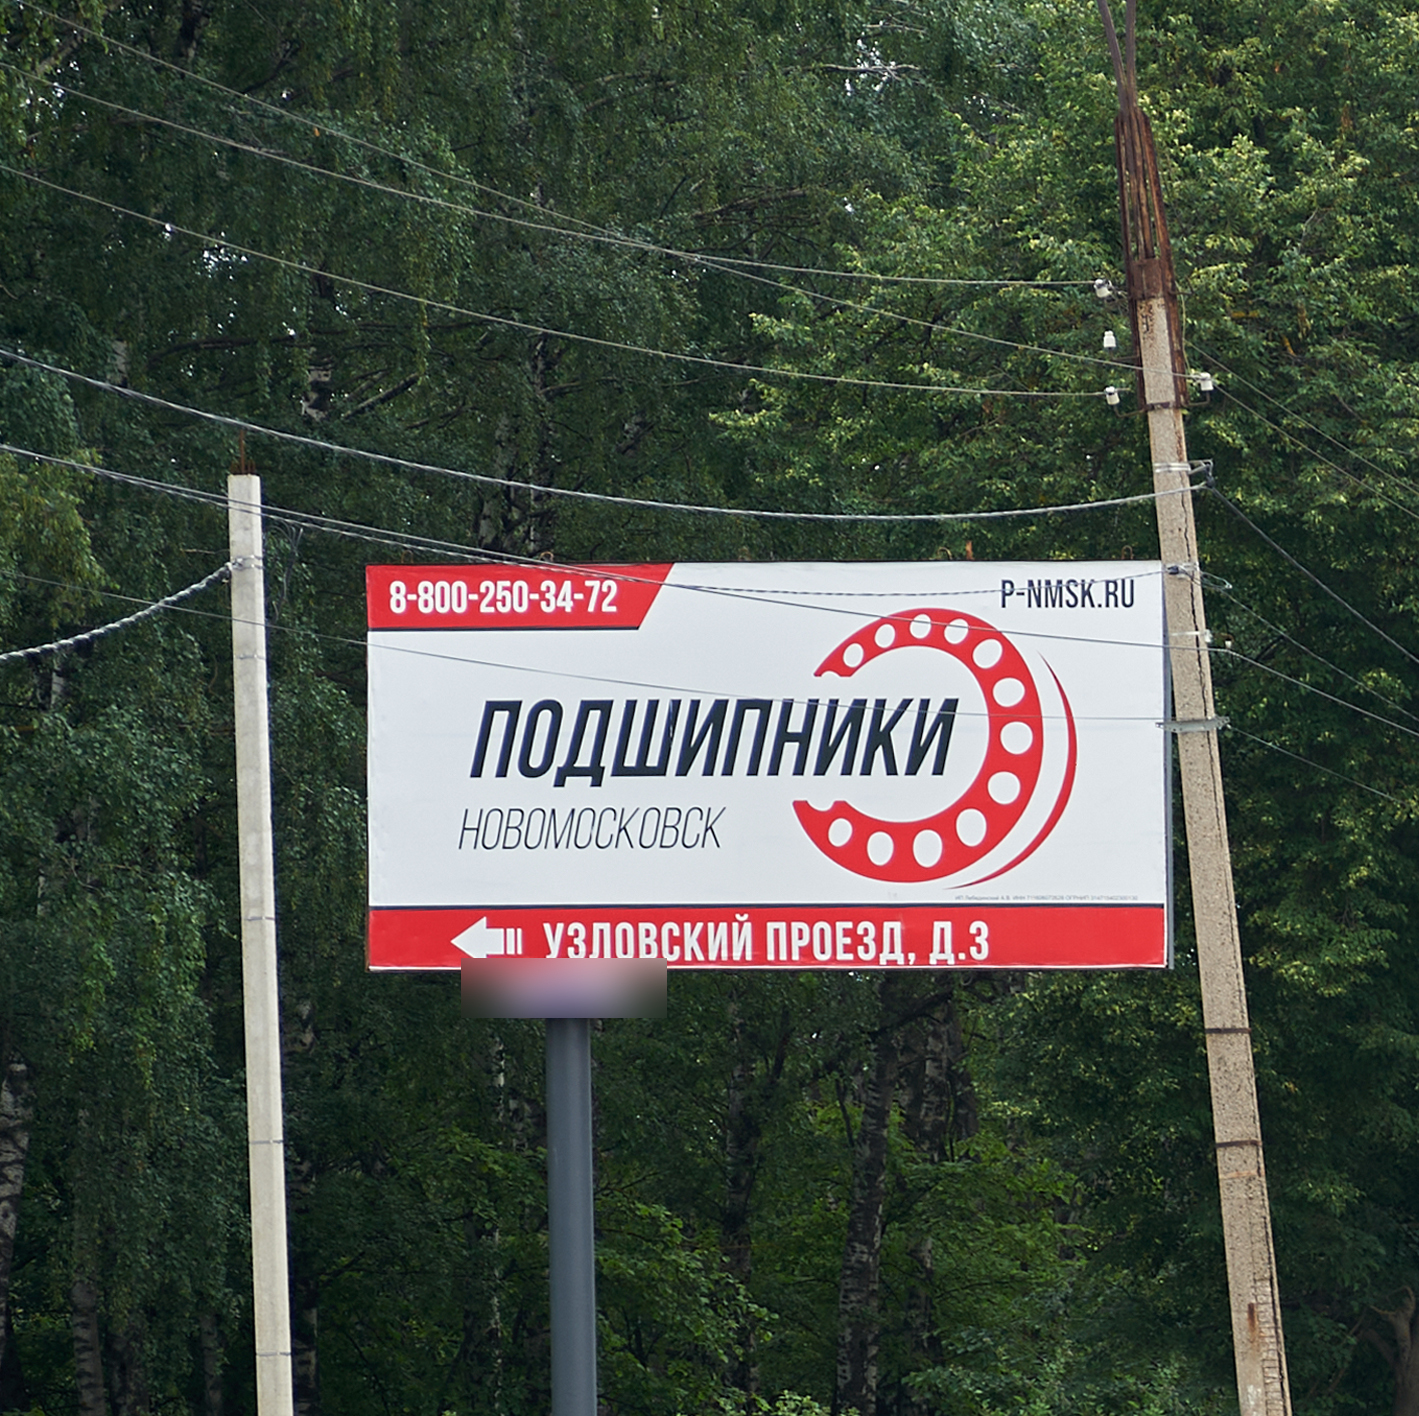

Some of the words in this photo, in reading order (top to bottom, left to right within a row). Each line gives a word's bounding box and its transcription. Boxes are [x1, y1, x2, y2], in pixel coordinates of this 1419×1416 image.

[389, 580, 618, 614] 8-800-250-34-72
[1001, 579, 1135, 608] P-NMSK.RU
[469, 697, 959, 787] ПОДШИПНИКИ
[458, 806, 727, 850] НОВОМОСКОВСК
[543, 913, 753, 962] УЗЛОВСКИЙ
[766, 920, 916, 966] ПРОЕЗД,
[929, 920, 990, 966] Д.3
